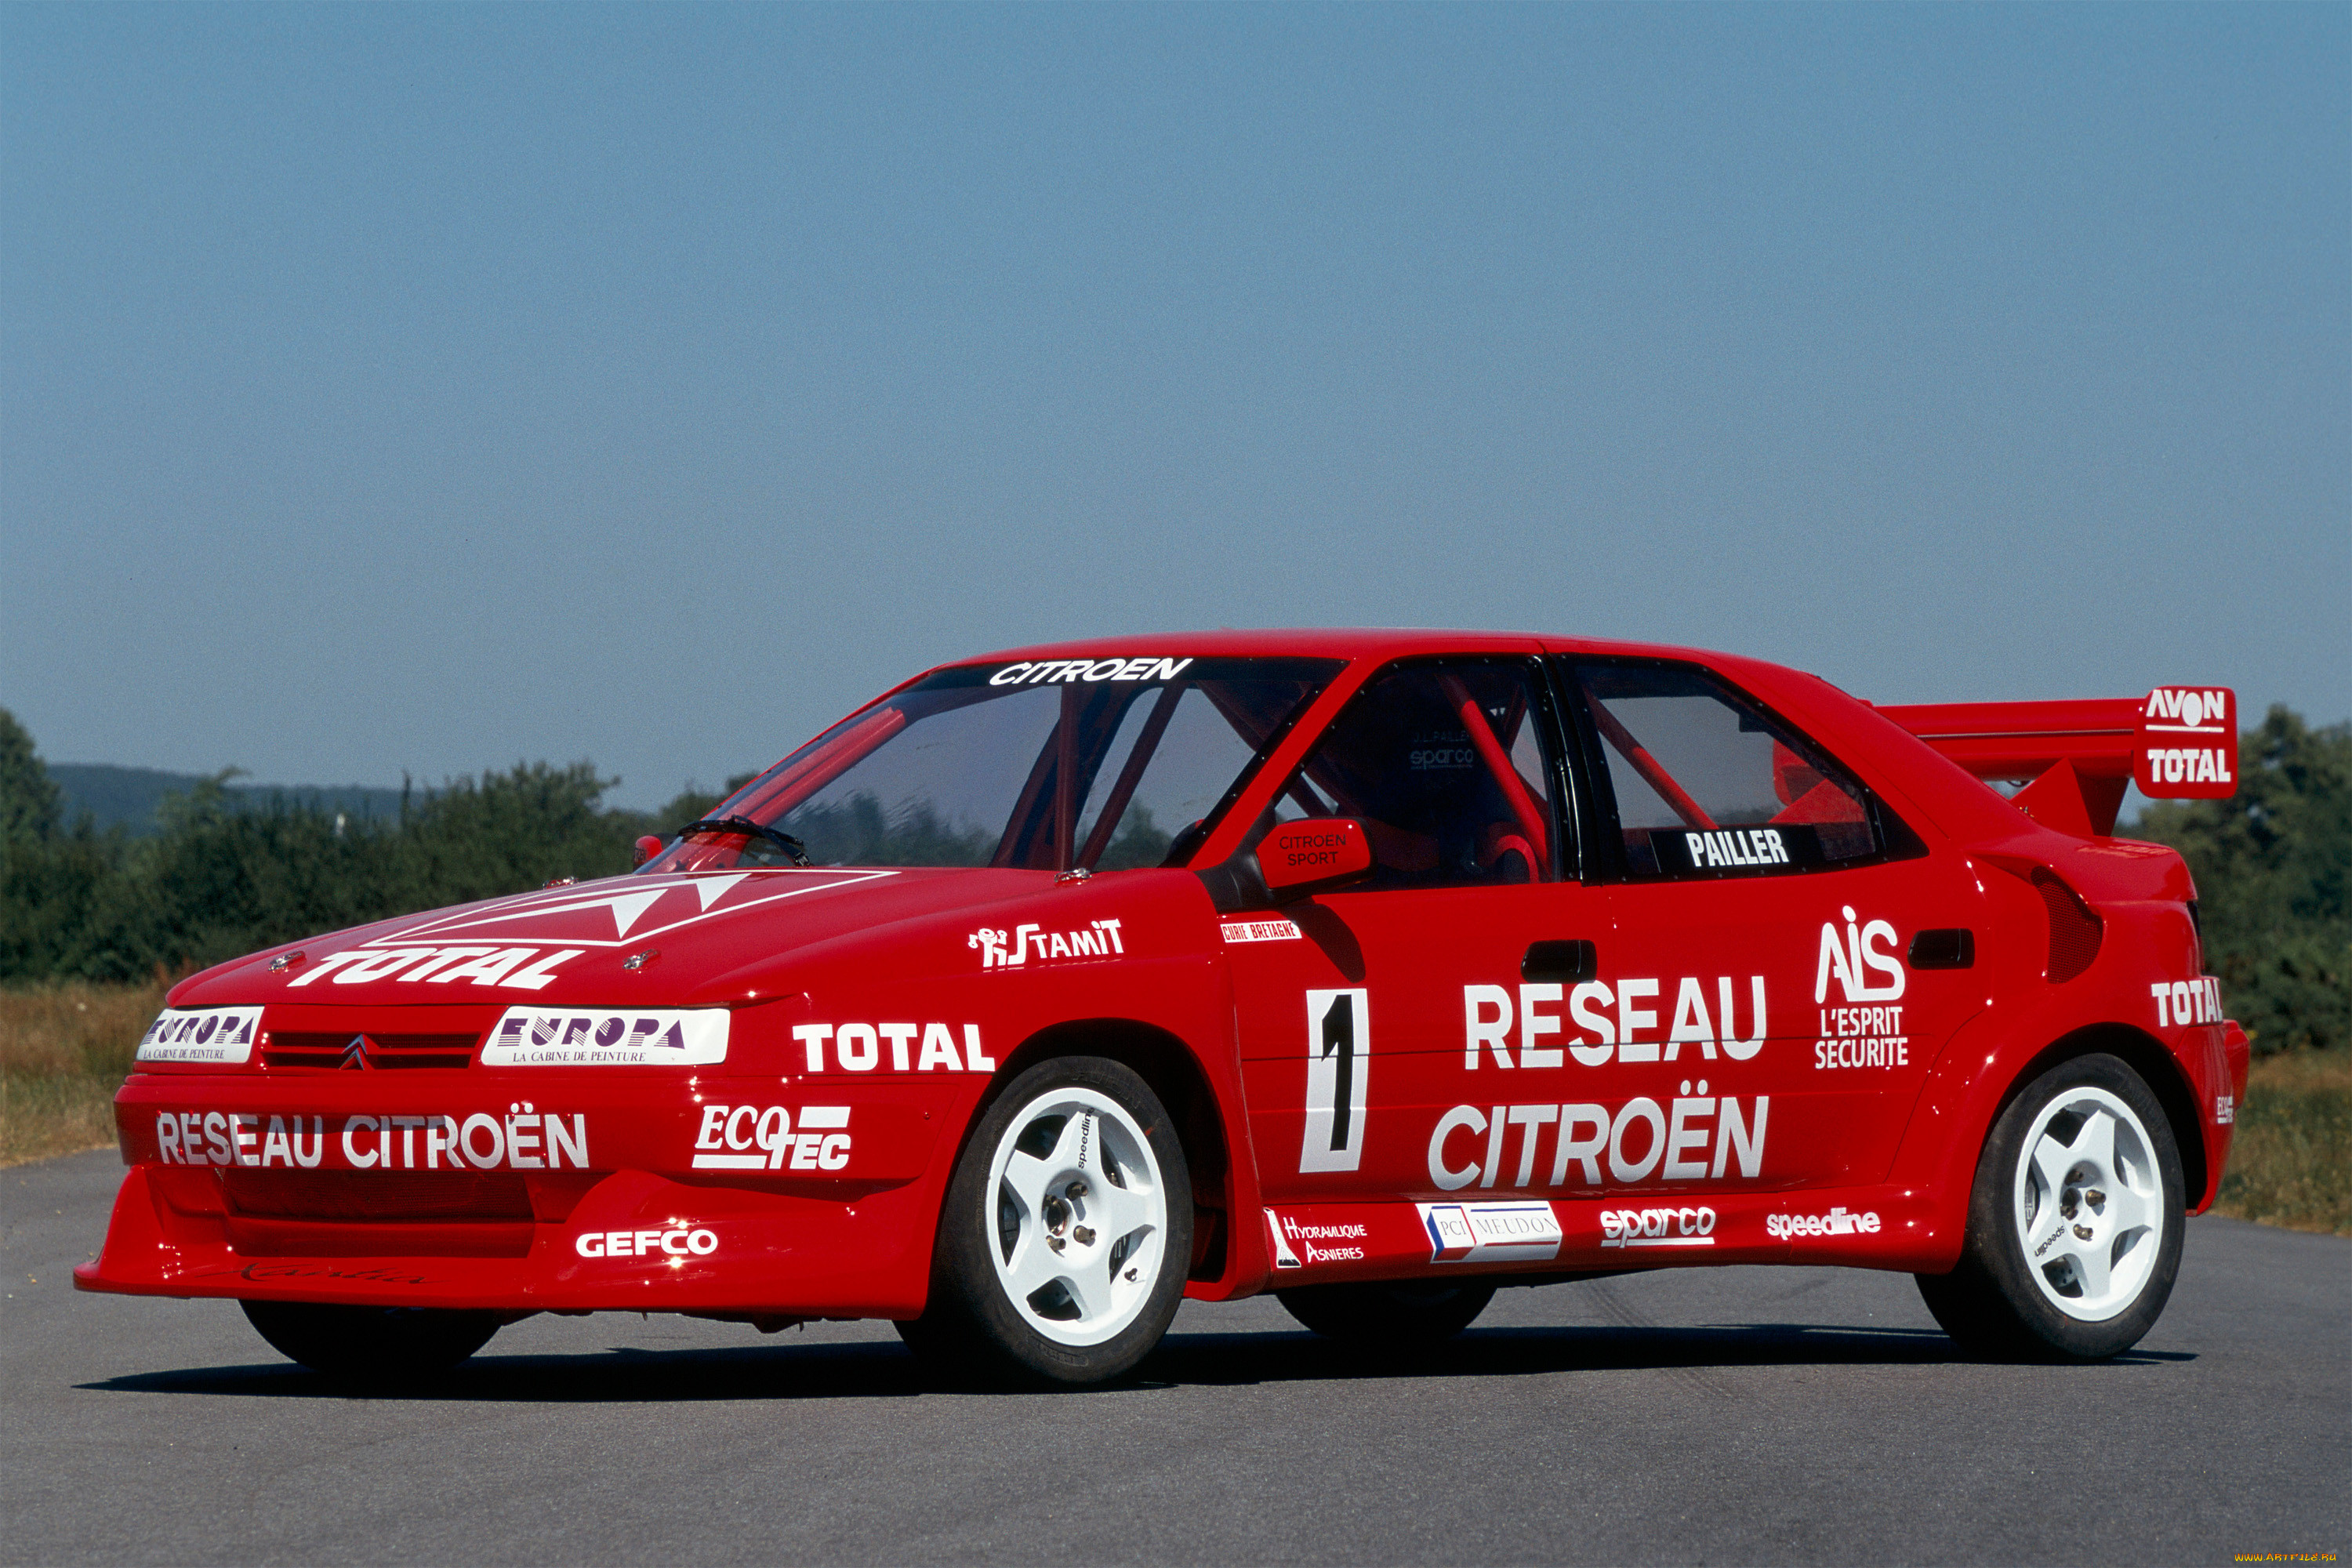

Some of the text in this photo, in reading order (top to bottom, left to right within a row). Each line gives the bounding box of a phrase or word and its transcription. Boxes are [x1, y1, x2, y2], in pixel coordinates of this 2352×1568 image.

[989, 657, 1193, 686] CITROEN
[2146, 689, 2225, 727] AVON
[1410, 748, 1474, 770] sparco
[2147, 749, 2231, 782] TOTAL
[1287, 851, 1338, 866] SPORT
[1686, 829, 1790, 867] PAILLER
[1222, 922, 1296, 941] CURIE BRETAGNE
[287, 947, 586, 990] TOTAL
[2151, 979, 2223, 1027] TOTAL
[140, 1015, 255, 1046] EUROPA
[497, 1015, 686, 1050] EUROPA
[1464, 976, 1768, 1070] RESEAU
[1820, 1006, 1903, 1037] L'ESPRIT
[143, 1049, 225, 1059] LA CABINE DE PEINTURE
[512, 1051, 647, 1062] LA CABINE DE PEINTURE
[793, 1022, 996, 1073] TOTAL
[1815, 1037, 1908, 1069] SECURITE
[1321, 994, 1354, 1151] 1
[157, 1102, 590, 1169] RESEAU CITROËN
[1078, 1106, 1095, 1169] speedline
[1428, 1079, 1769, 1190] CITROËN
[1440, 1216, 1559, 1236] PCI MEUDON
[1600, 1207, 1716, 1248] sparco
[1766, 1207, 1882, 1240] speedline
[575, 1229, 719, 1258] GEFCO
[1305, 1240, 1364, 1263] ASNIERES
[2034, 1225, 2065, 1257] speedlin
